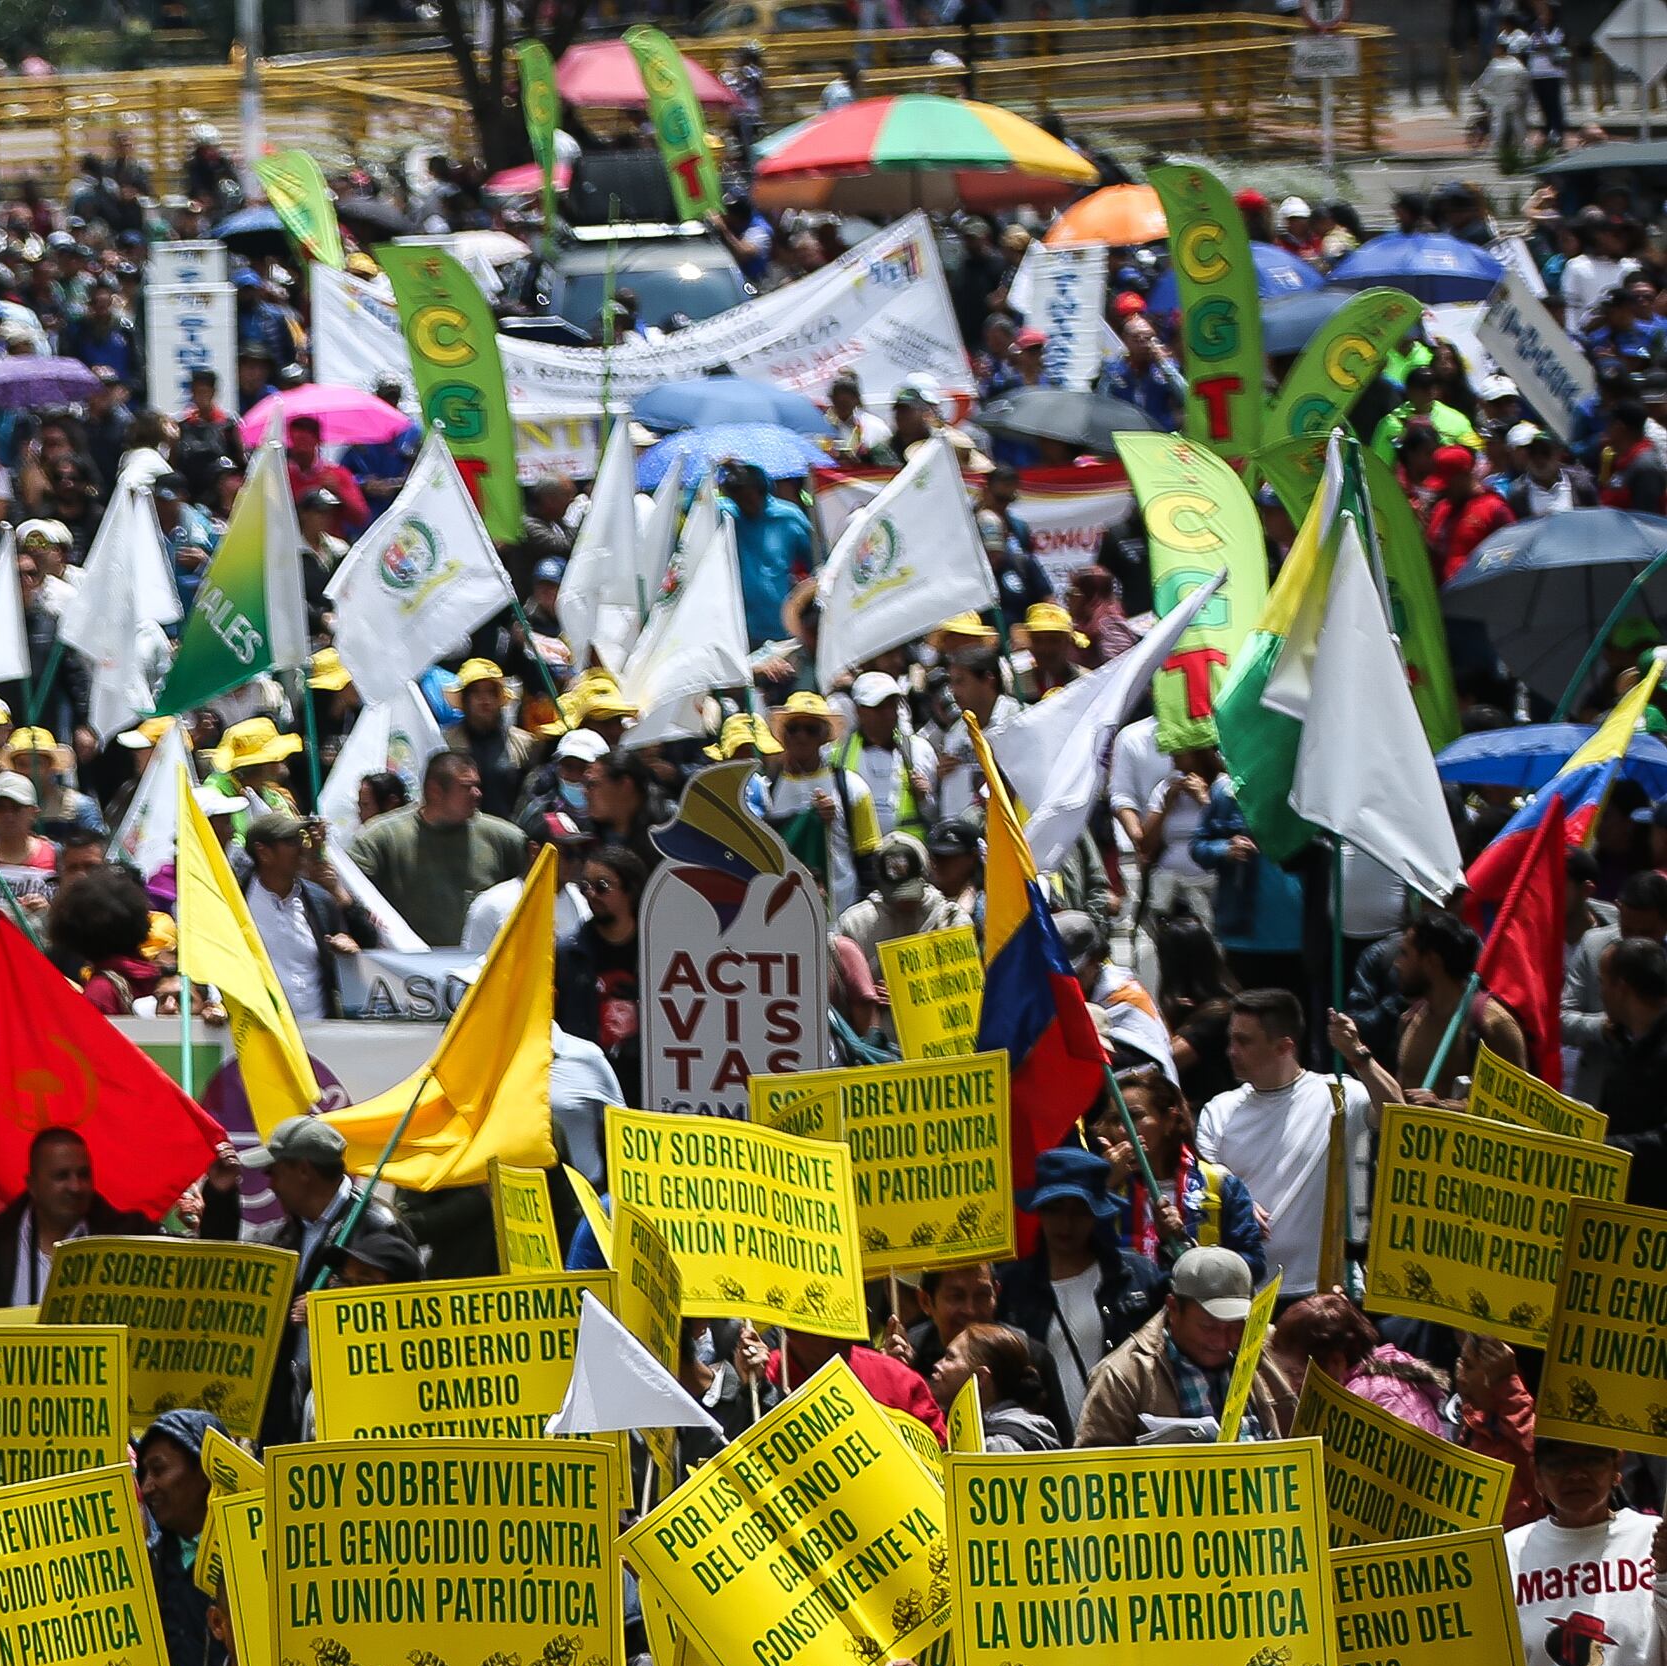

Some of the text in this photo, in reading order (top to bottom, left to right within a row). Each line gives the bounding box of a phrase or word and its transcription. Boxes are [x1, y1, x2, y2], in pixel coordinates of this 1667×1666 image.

[1178, 222, 1245, 439] CGT
[658, 951, 801, 996] ACTI
[661, 998, 801, 1042] VIS
[621, 1125, 835, 1193] SOY SOBREVIVIENTE
[621, 1168, 842, 1235] DEL GENOCIDIO CONTRA
[655, 1212, 844, 1277] UNIÓN PATRIÓTICA
[288, 1460, 598, 1511] SOY SOBREVIVIENTE
[968, 1464, 1301, 1526] SOY SOBREVIVIENTE
[49, 1546, 135, 1603] CONTRA
[285, 1518, 602, 1570] DEL GENOCIDIO CONTRA
[968, 1525, 1309, 1587] DEL GENOCIDIO CONTRA
[290, 1567, 600, 1628] LA UNIÓN PATRIÓTICA
[974, 1580, 1309, 1649] LA UNIÓN PATRIÓTICA
